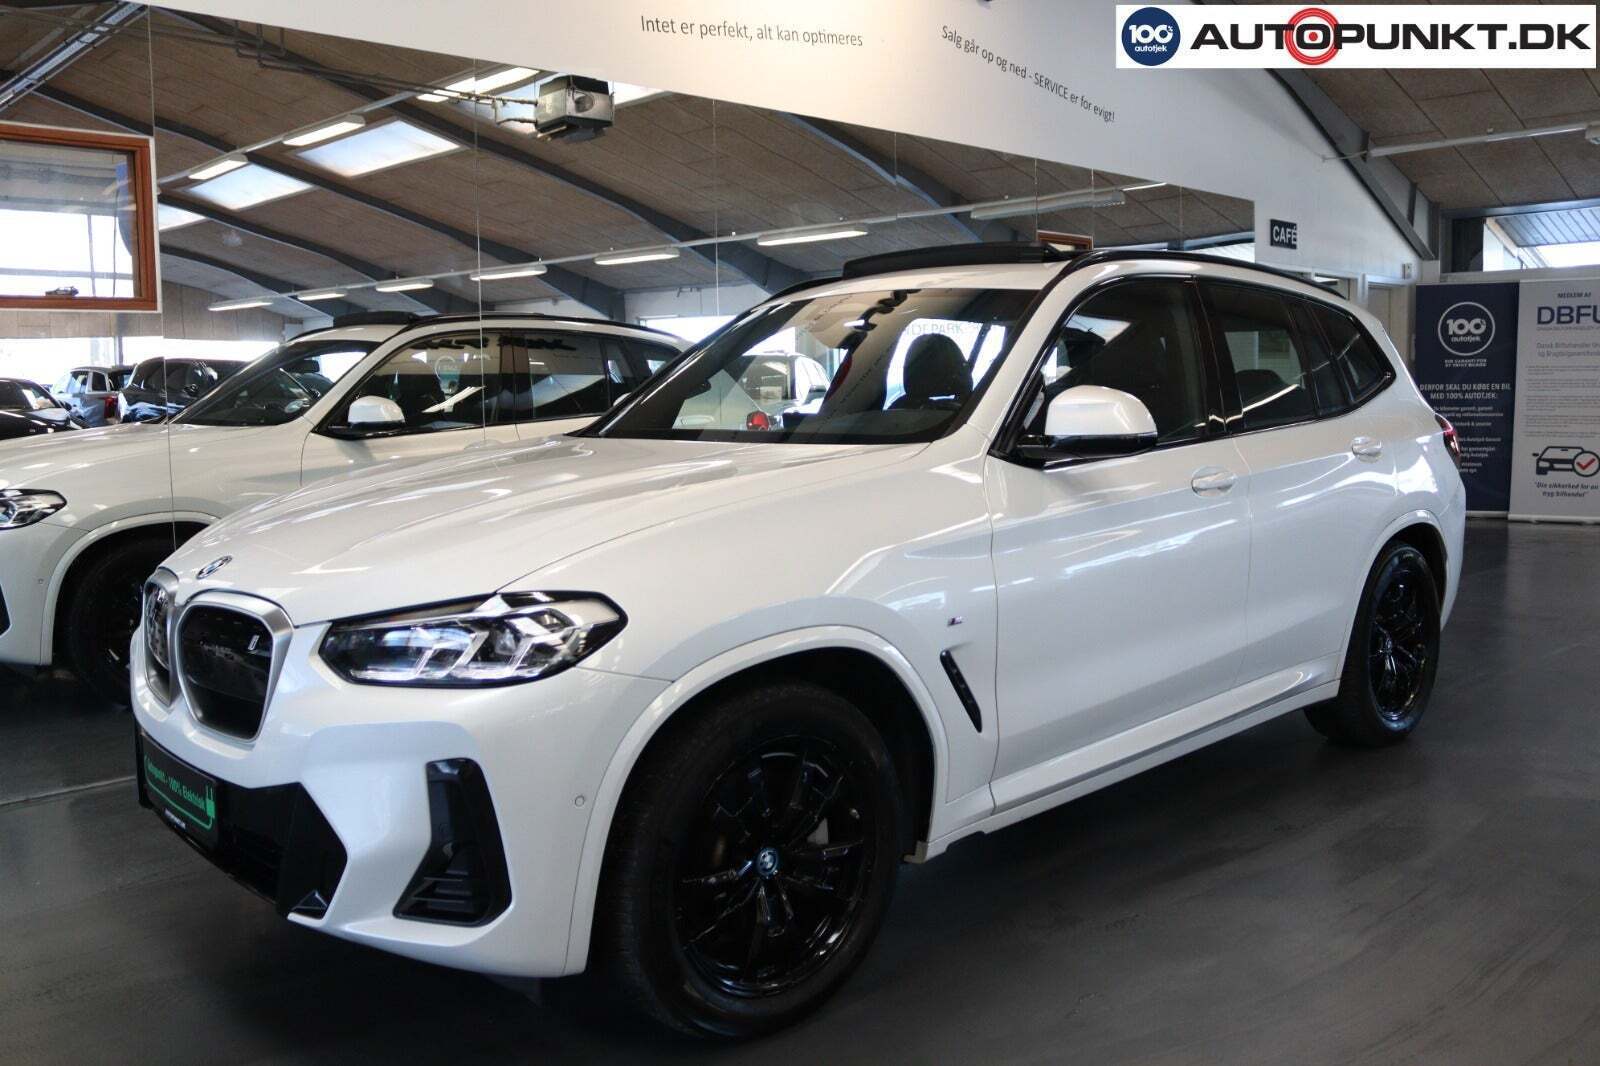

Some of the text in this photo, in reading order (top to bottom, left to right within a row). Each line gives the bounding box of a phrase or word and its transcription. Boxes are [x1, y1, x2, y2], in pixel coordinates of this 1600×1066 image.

[641, 15, 863, 47] Intet er perfekt, alt kan optimeres
[942, 25, 962, 49] Salg
[963, 39, 980, 54] går
[981, 48, 995, 64] op
[996, 56, 1008, 72] og
[1009, 62, 1027, 79] ned
[1033, 72, 1069, 100] SERVICE
[1070, 93, 1079, 104] er
[1080, 95, 1093, 111] for
[1093, 105, 1115, 123] evigt!
[1272, 225, 1298, 246] CAFÉ
[1445, 383, 1461, 391] SKAL
[1462, 383, 1472, 391] DU
[1491, 383, 1500, 391] EN
[1501, 383, 1511, 391] BIL
